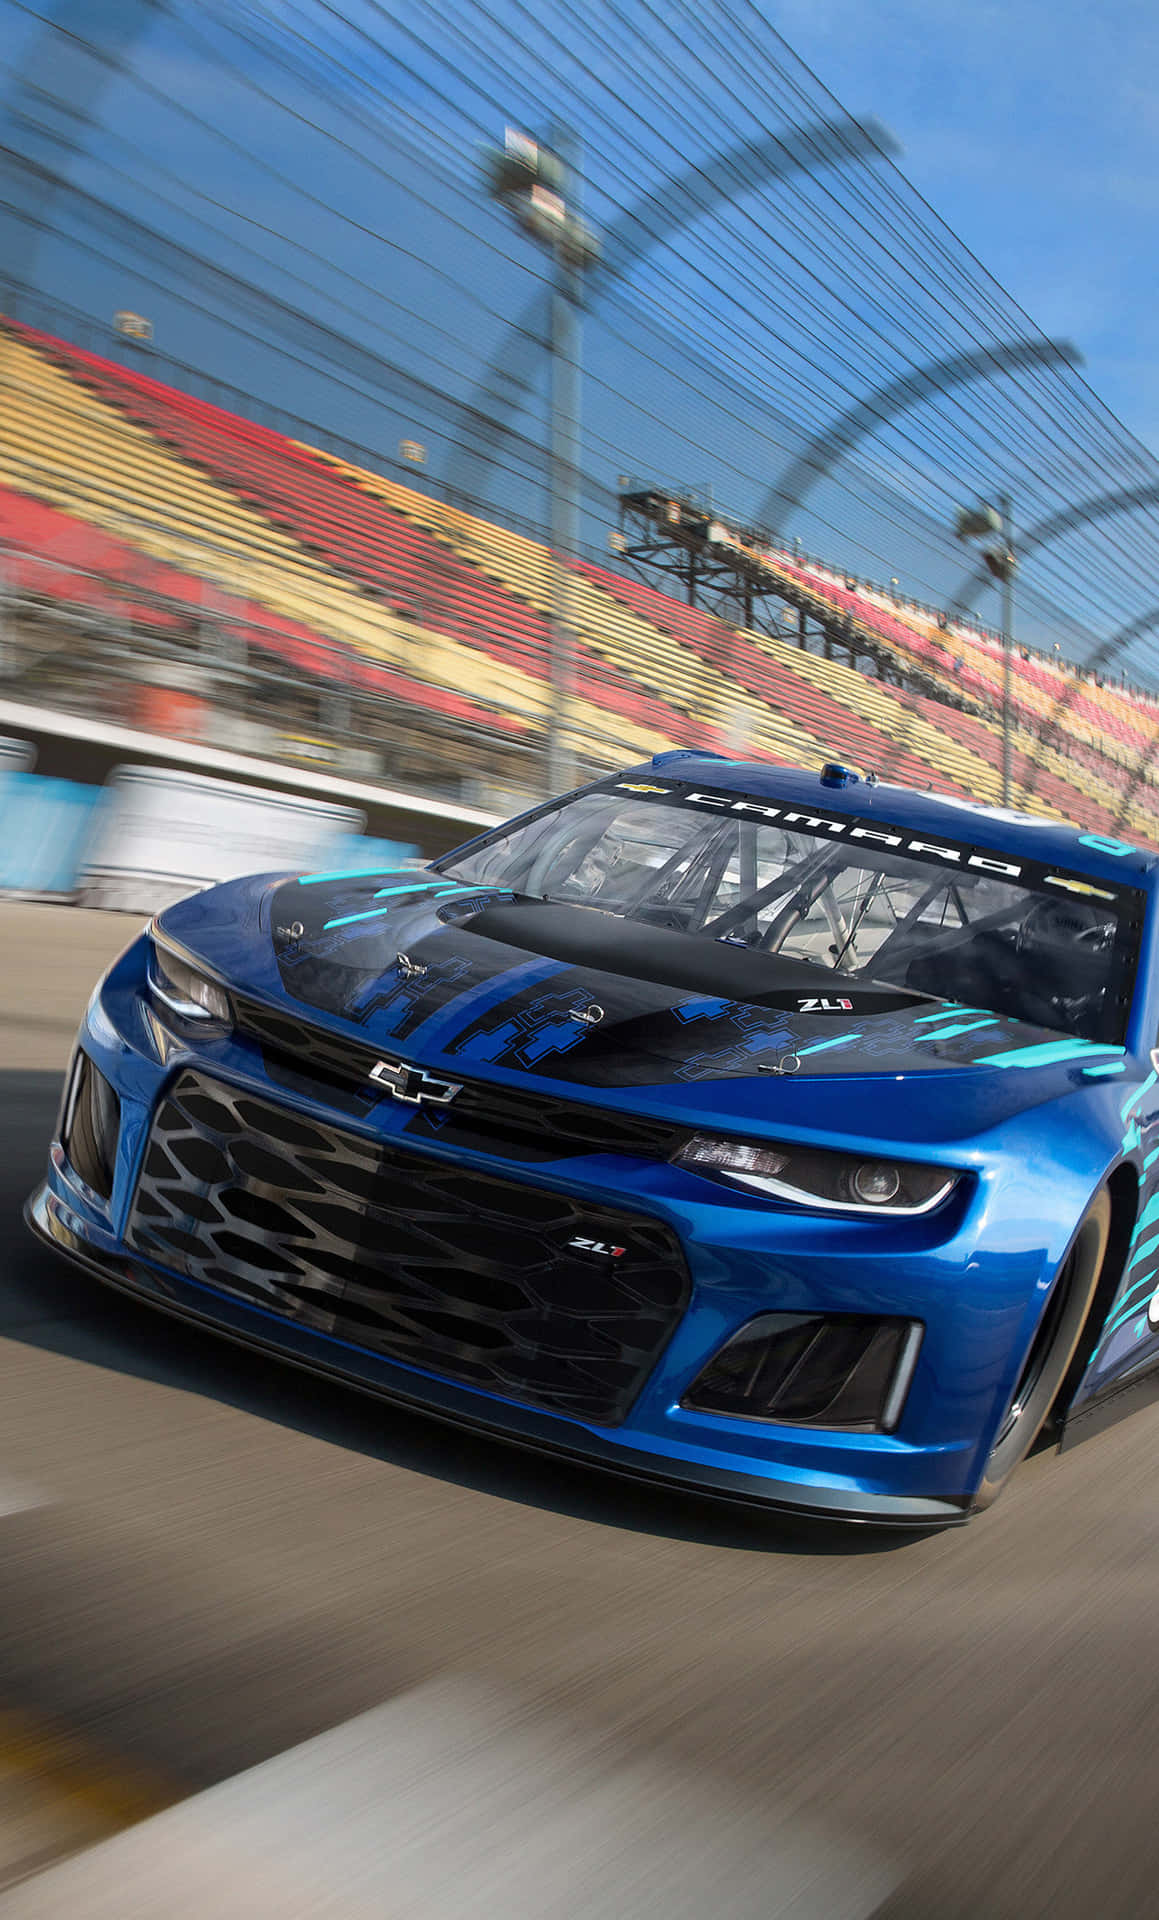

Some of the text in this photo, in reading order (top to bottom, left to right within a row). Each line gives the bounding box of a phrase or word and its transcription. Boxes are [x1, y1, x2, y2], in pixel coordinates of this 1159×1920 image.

[684, 793, 1022, 878] CAMARO
[797, 998, 854, 1013] ZL1
[568, 1236, 626, 1257] ZL1
